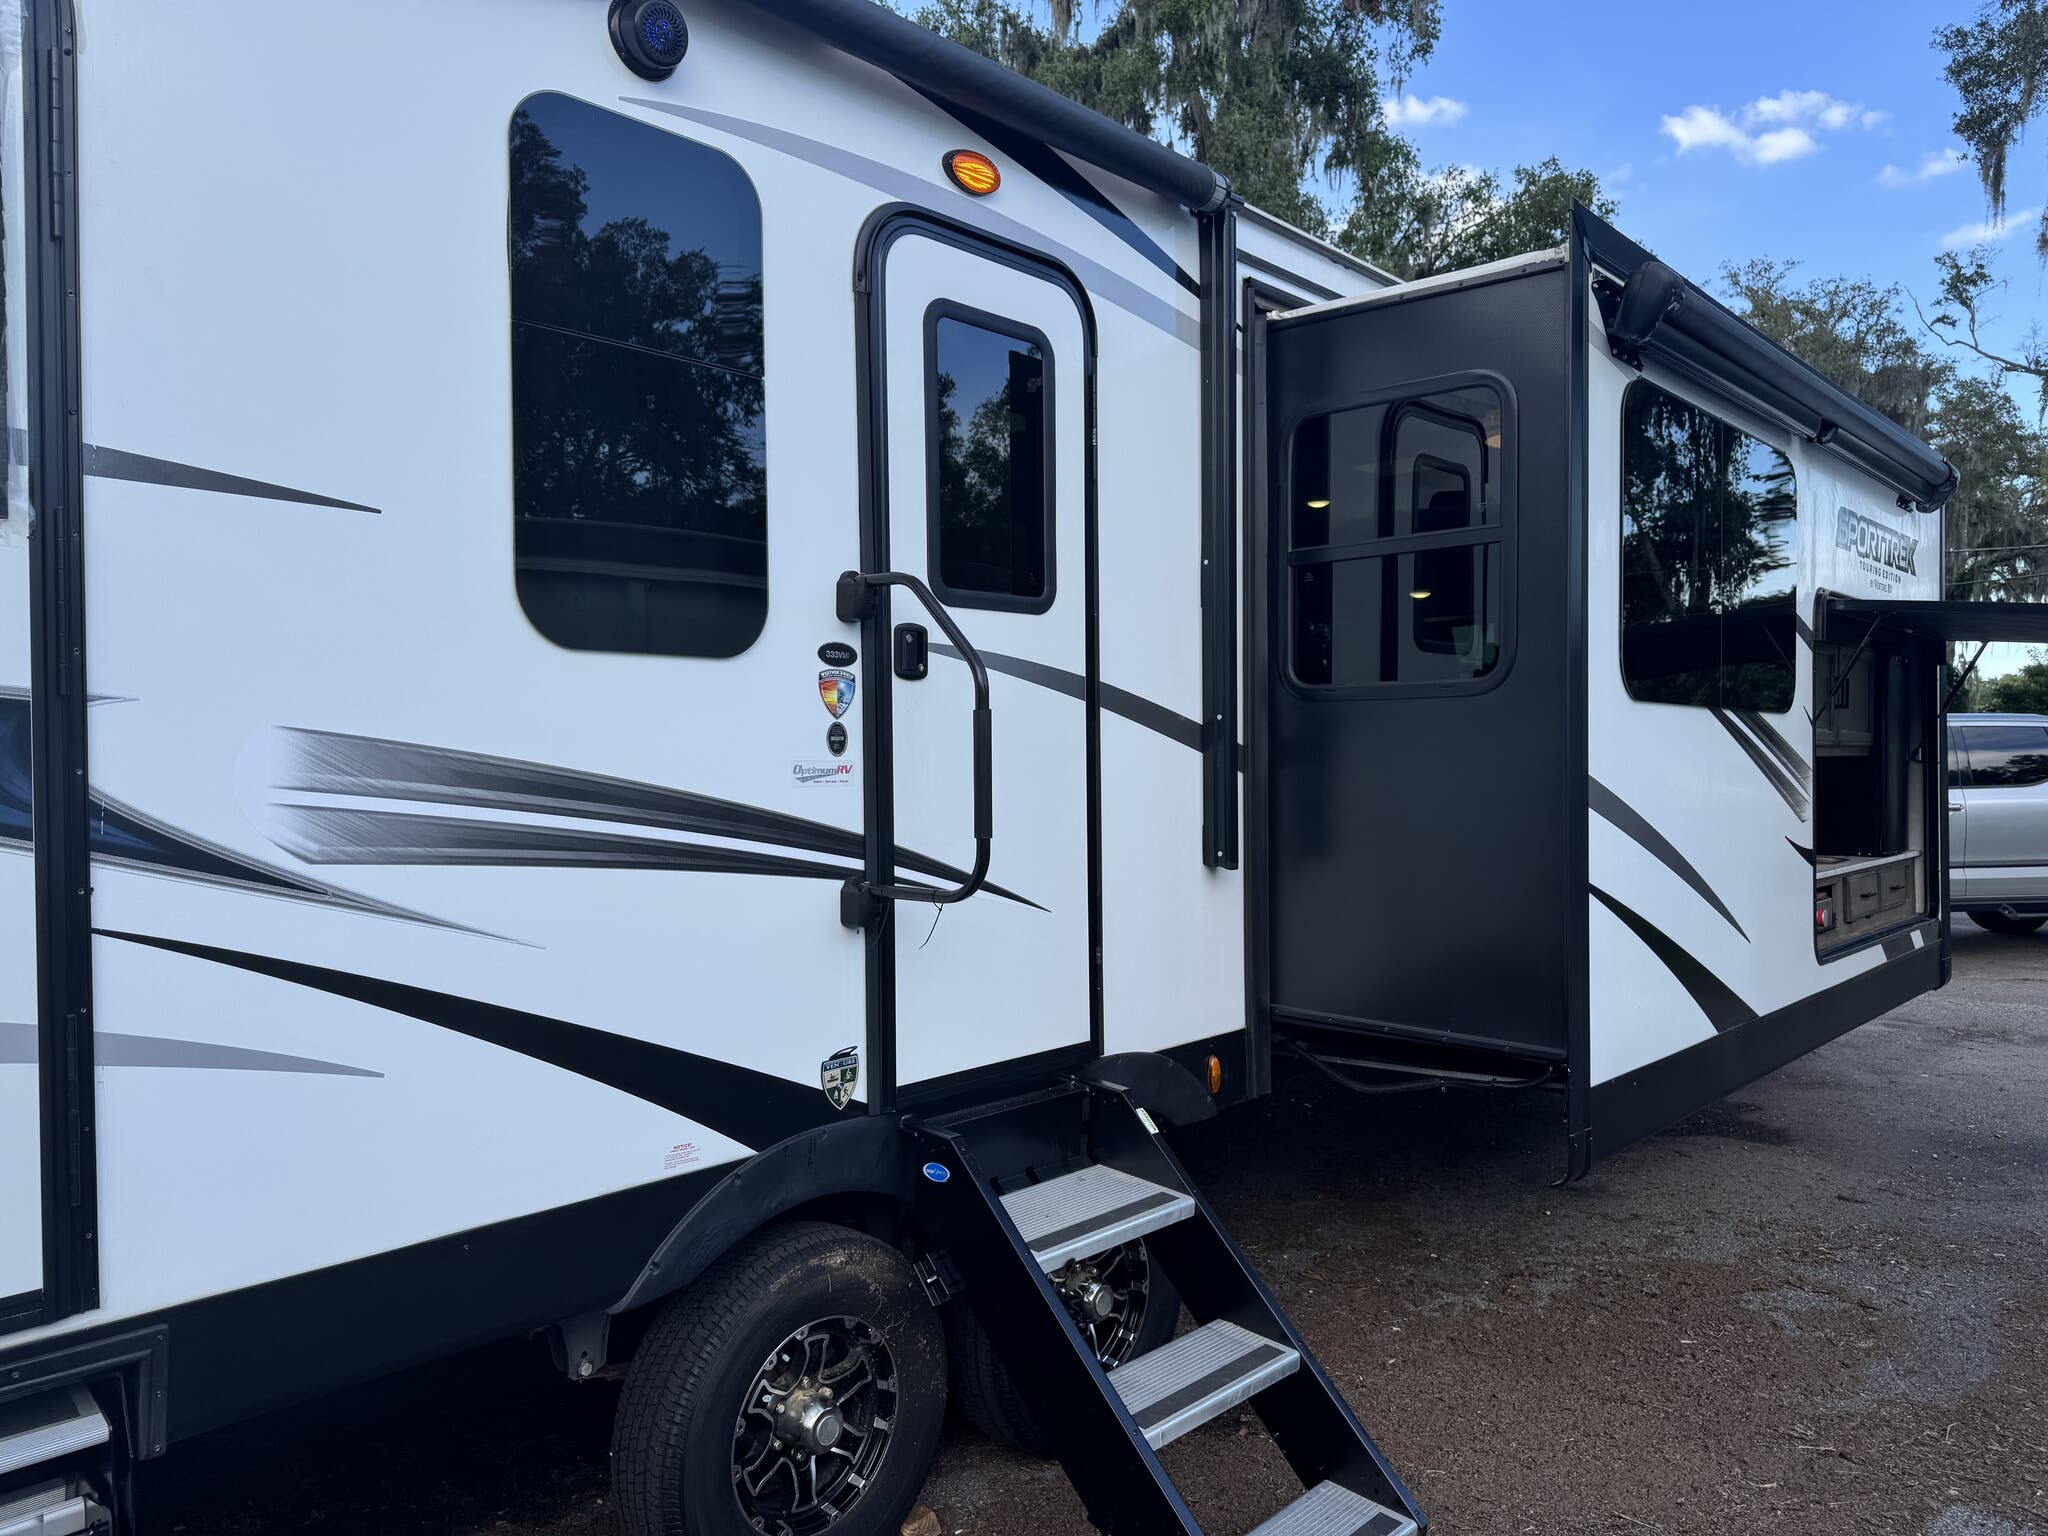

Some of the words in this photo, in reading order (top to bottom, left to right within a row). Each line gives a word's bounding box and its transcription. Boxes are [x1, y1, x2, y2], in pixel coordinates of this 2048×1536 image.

[1836, 506, 1919, 576] SPORTTREK
[1859, 560, 1881, 577] TOURING
[1882, 569, 1901, 584] EDITION
[793, 764, 853, 776] OptimumRV
